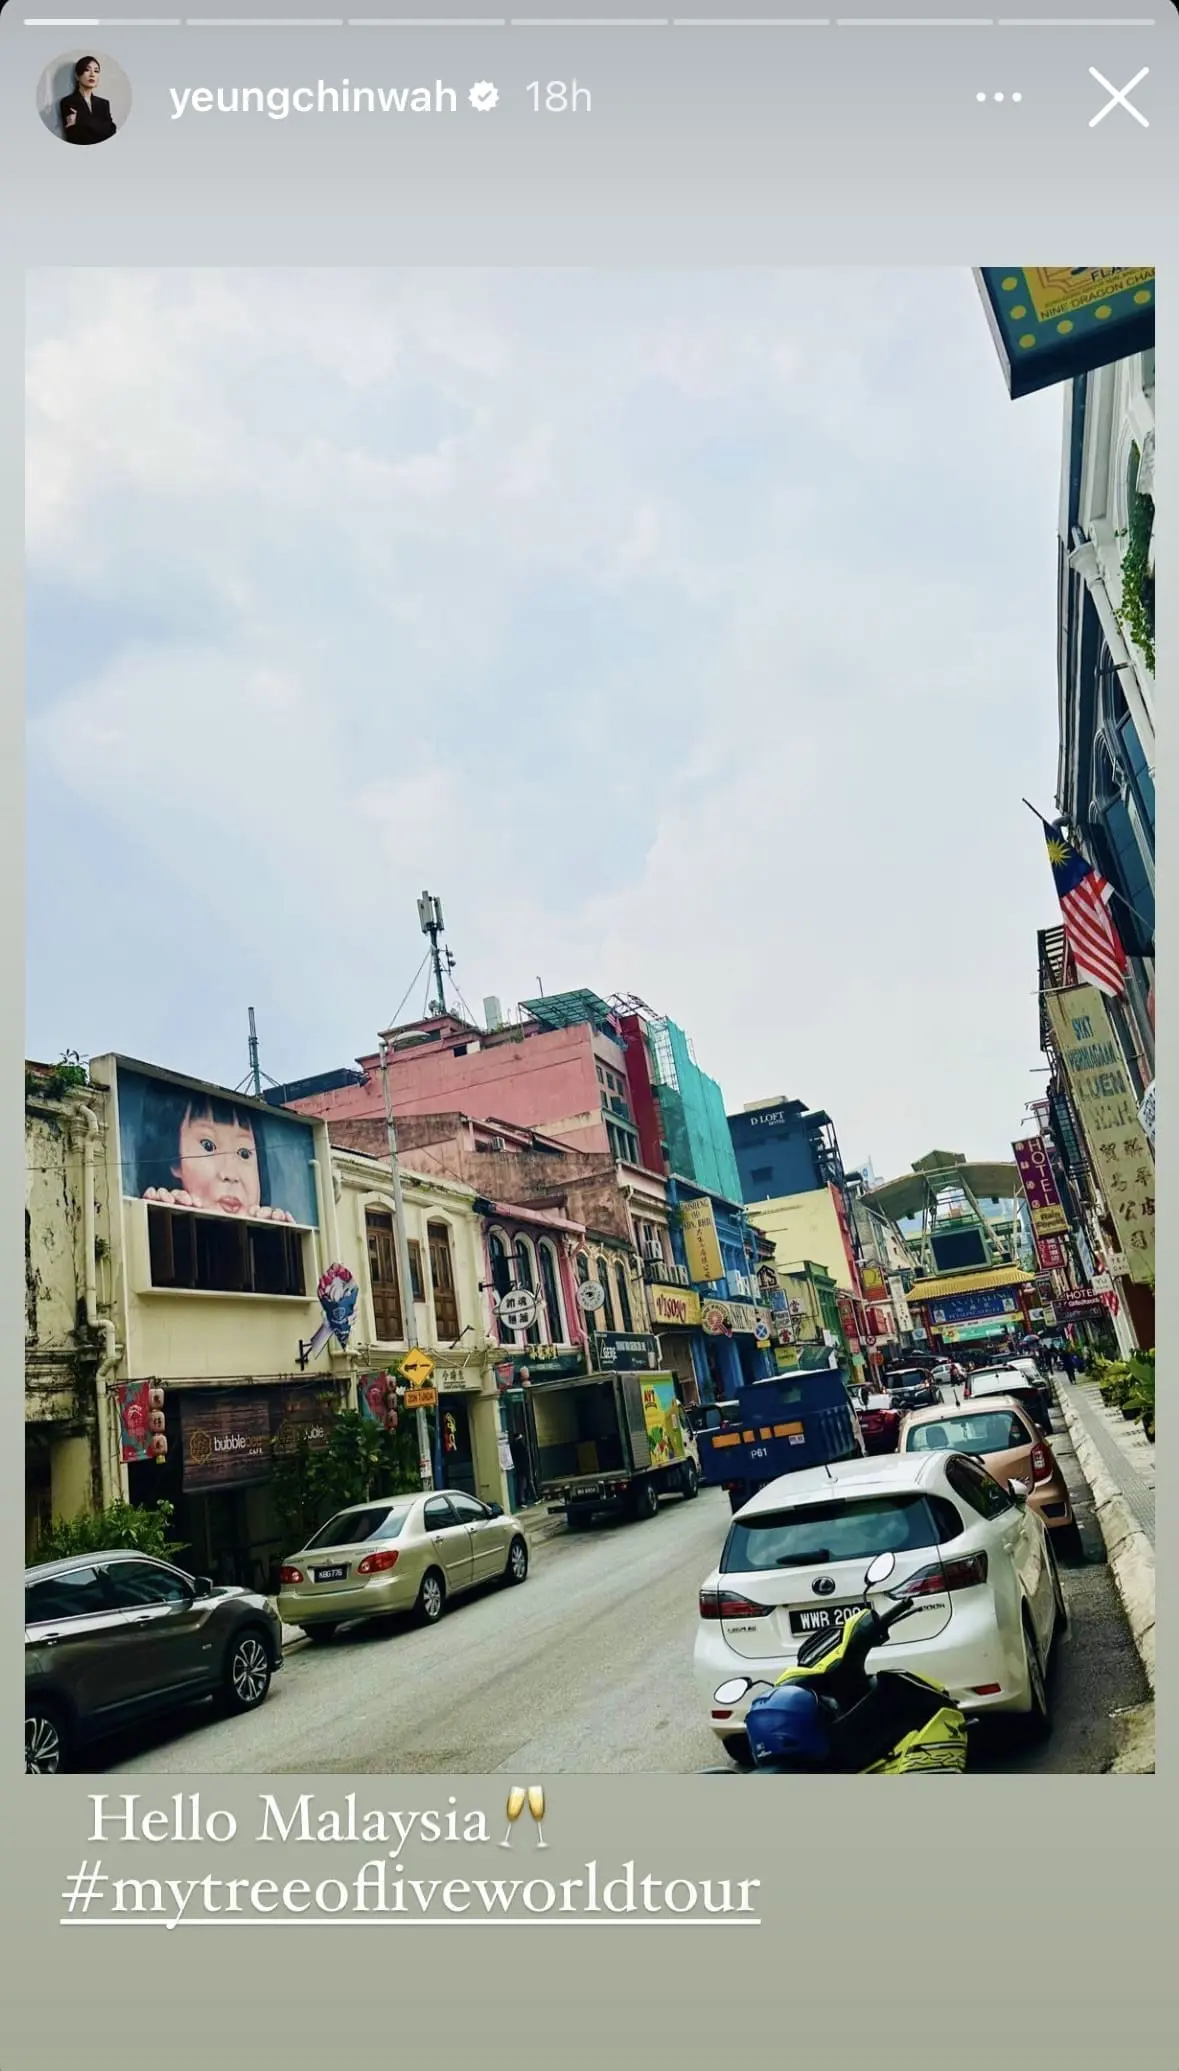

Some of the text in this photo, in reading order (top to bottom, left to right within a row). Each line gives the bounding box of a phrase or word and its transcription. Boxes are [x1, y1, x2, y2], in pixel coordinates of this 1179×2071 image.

[1070, 283, 1124, 308] DRAGON
[1126, 269, 1155, 287] CHA
[1077, 1069, 1127, 1101] LUEN
[750, 1110, 785, 1126] D LOFT
[1028, 1139, 1056, 1207] HOTEL
[751, 1447, 768, 1460] P61
[800, 1610, 830, 1630] WWR
